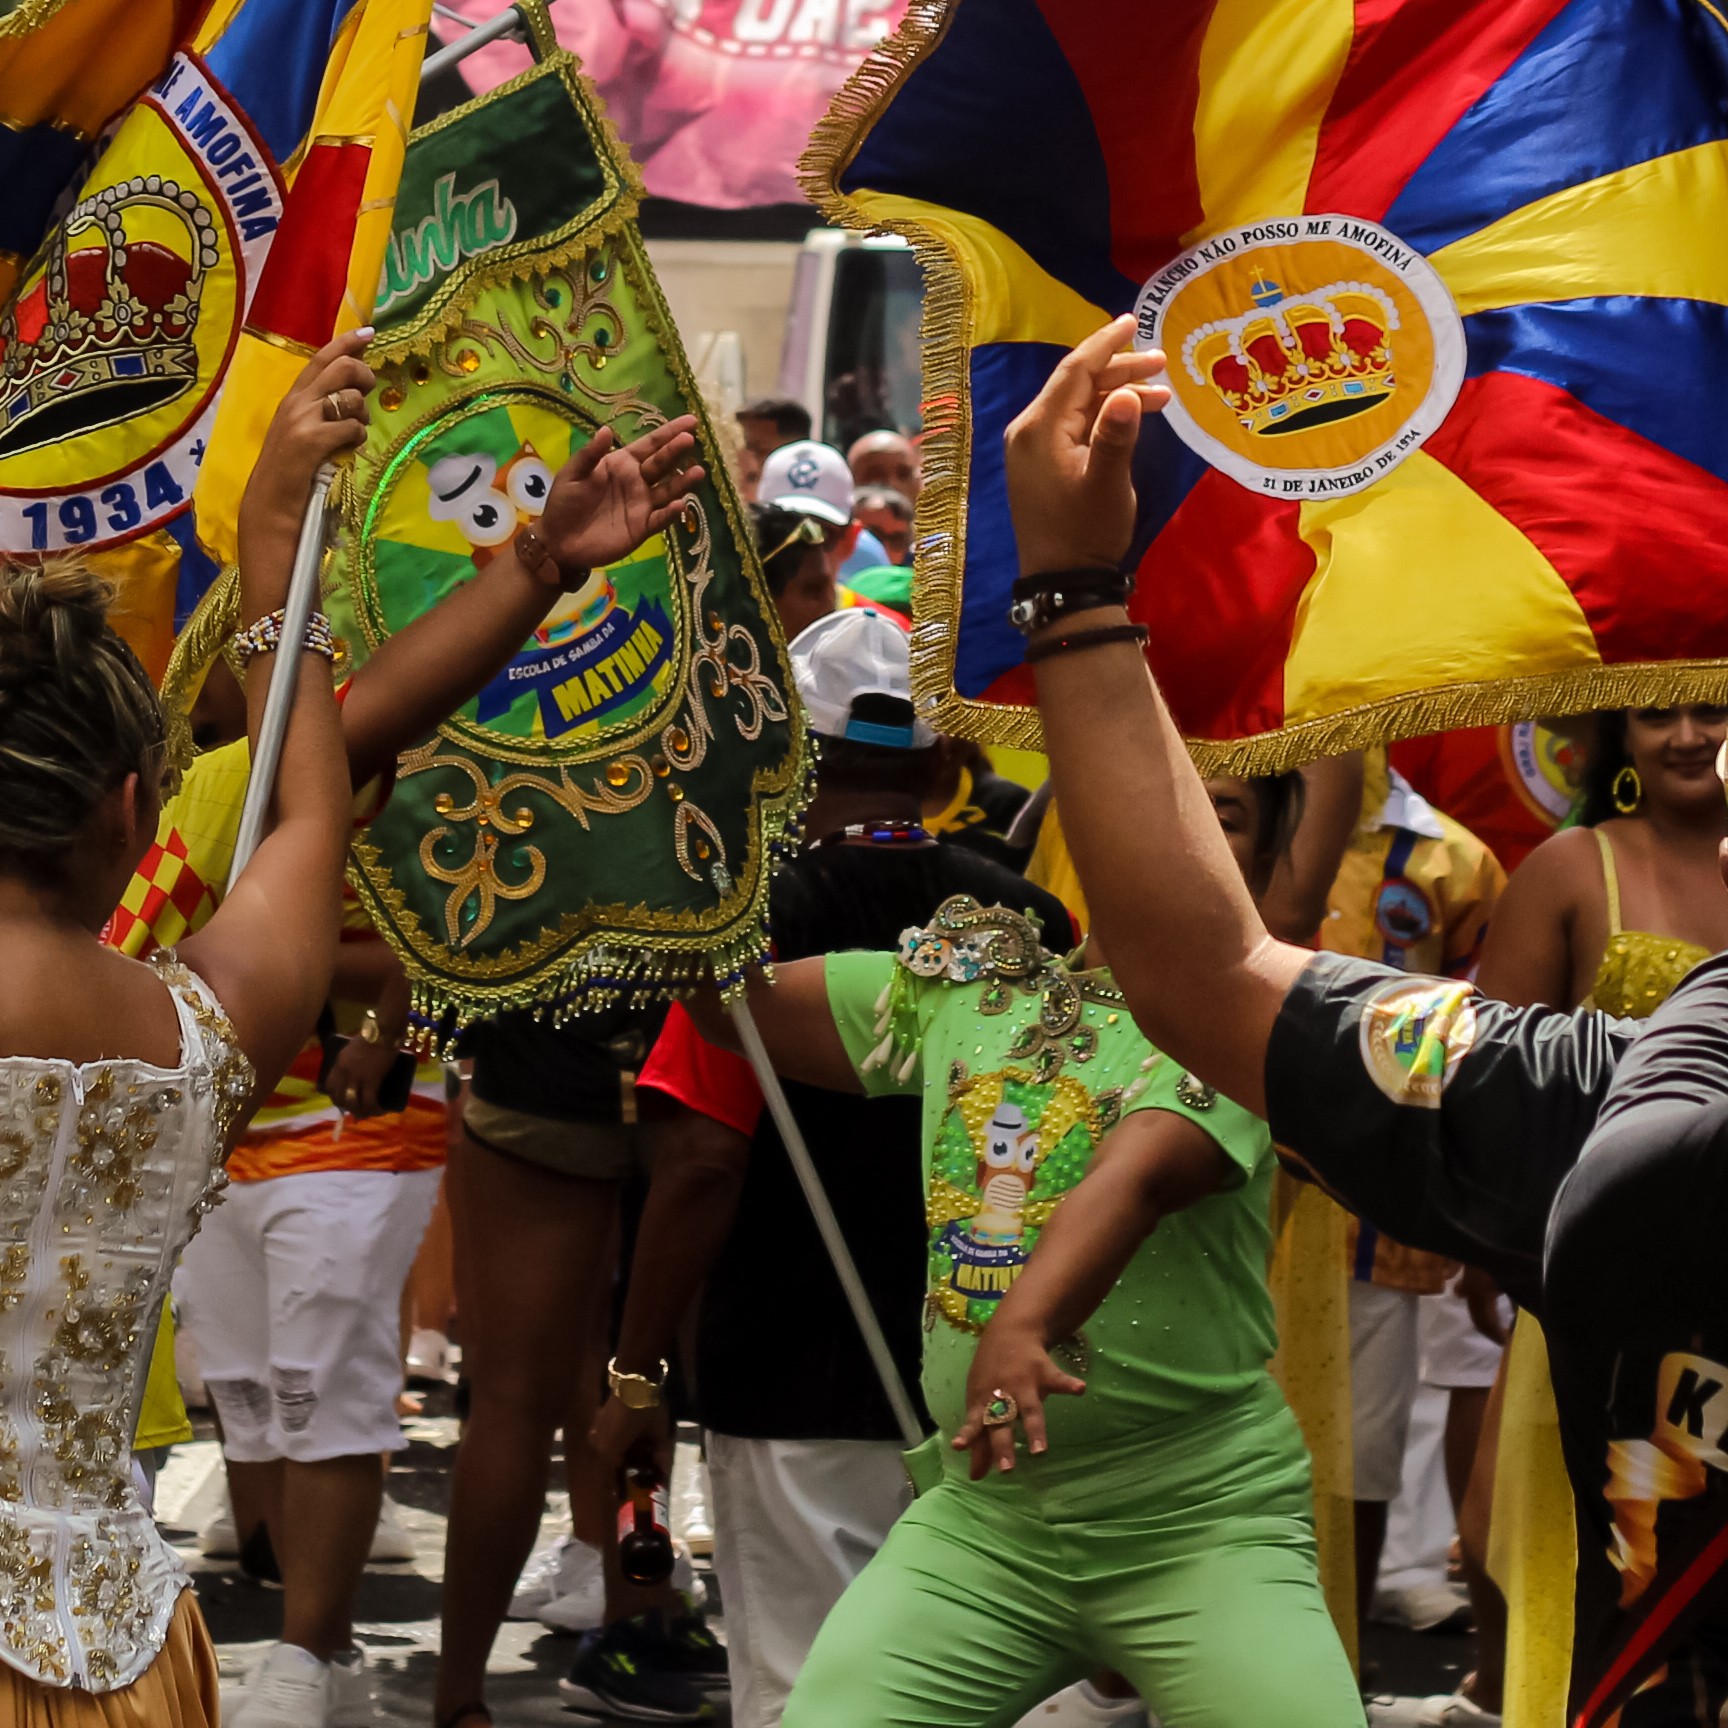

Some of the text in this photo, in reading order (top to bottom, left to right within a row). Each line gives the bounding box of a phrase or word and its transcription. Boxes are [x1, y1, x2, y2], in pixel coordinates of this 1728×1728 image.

[1146, 256, 1200, 306] RANCHO
[1197, 237, 1237, 264] NÃO
[1240, 221, 1300, 246] POSSO
[1306, 220, 1332, 236] ME
[1336, 223, 1414, 273] AMOFINÁ
[22, 467, 185, 551] 1934
[1263, 477, 1276, 489] 31
[1282, 479, 1303, 493] DE
[1308, 465, 1374, 493] JANEIRO
[1376, 450, 1397, 470] DE
[508, 621, 616, 681] ESCOLA DE SAMBA DA
[551, 619, 664, 723] MATINHA
